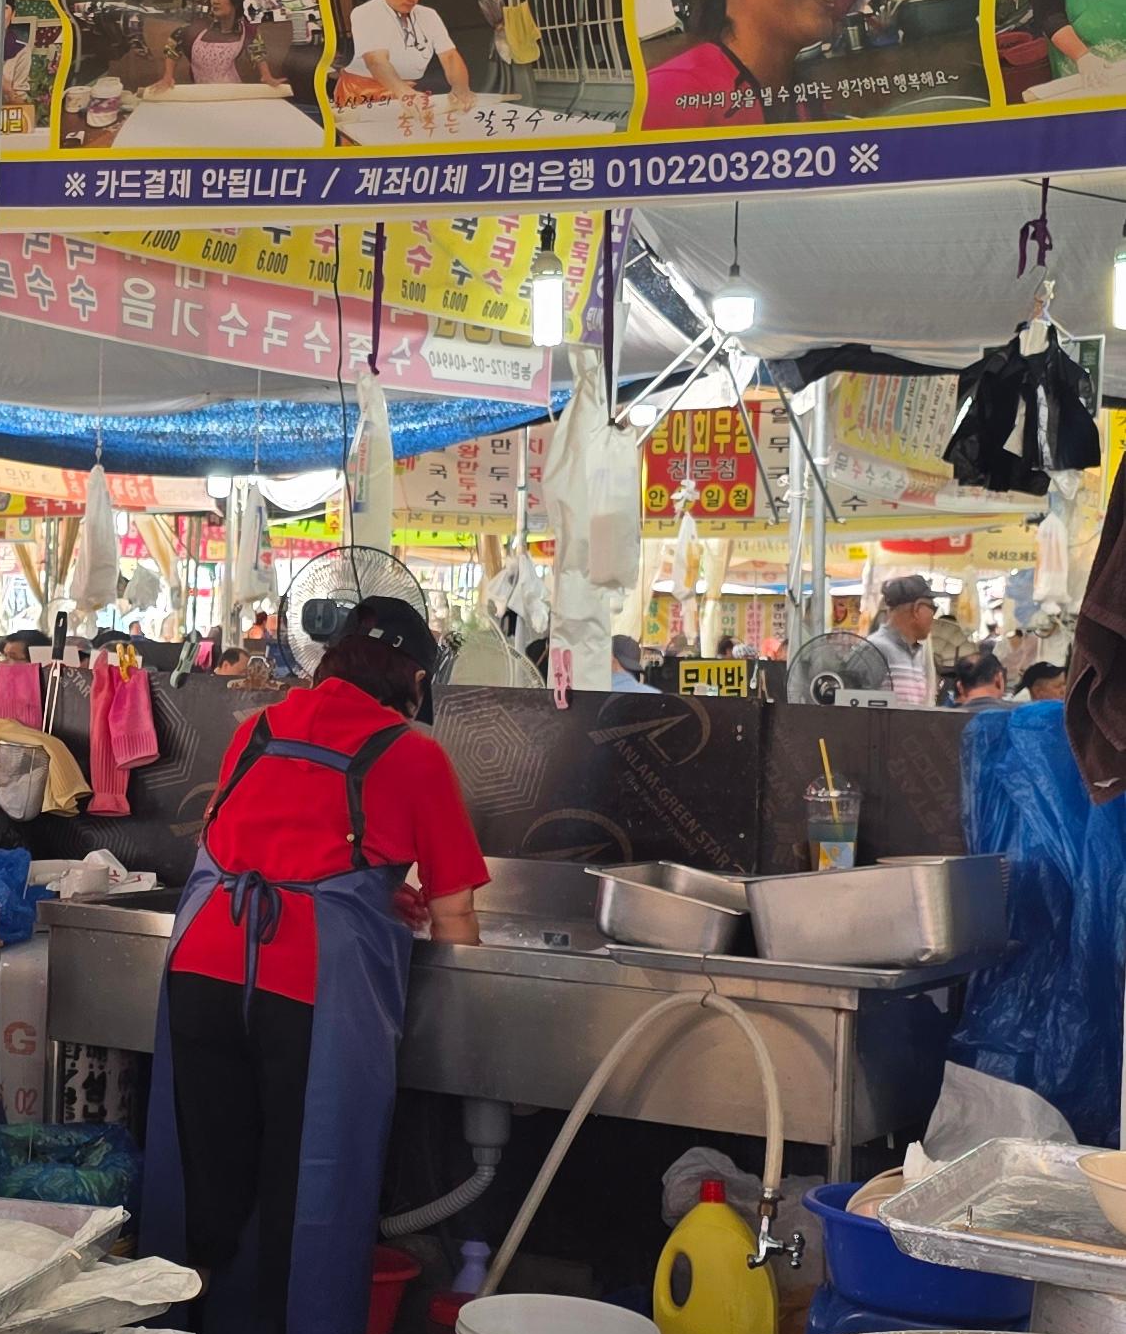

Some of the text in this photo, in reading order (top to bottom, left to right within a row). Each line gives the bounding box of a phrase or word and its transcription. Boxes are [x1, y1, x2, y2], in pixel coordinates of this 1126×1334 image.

[675, 92, 725, 109] 어머니의
[730, 89, 756, 108] 맛을
[778, 87, 790, 103] 수
[794, 82, 833, 104] 있다는
[837, 75, 891, 98] 생각하면
[474, 109, 547, 137] 칼국수
[95, 168, 192, 199] 카드결제
[200, 166, 307, 198] 안됩니다
[355, 159, 467, 196] 계좌이체
[478, 153, 595, 193] 기업은행
[607, 145, 835, 188] 01022032820
[201, 238, 237, 265] 6,000
[257, 250, 289, 275] 6,000
[668, 456, 737, 482] 전문점
